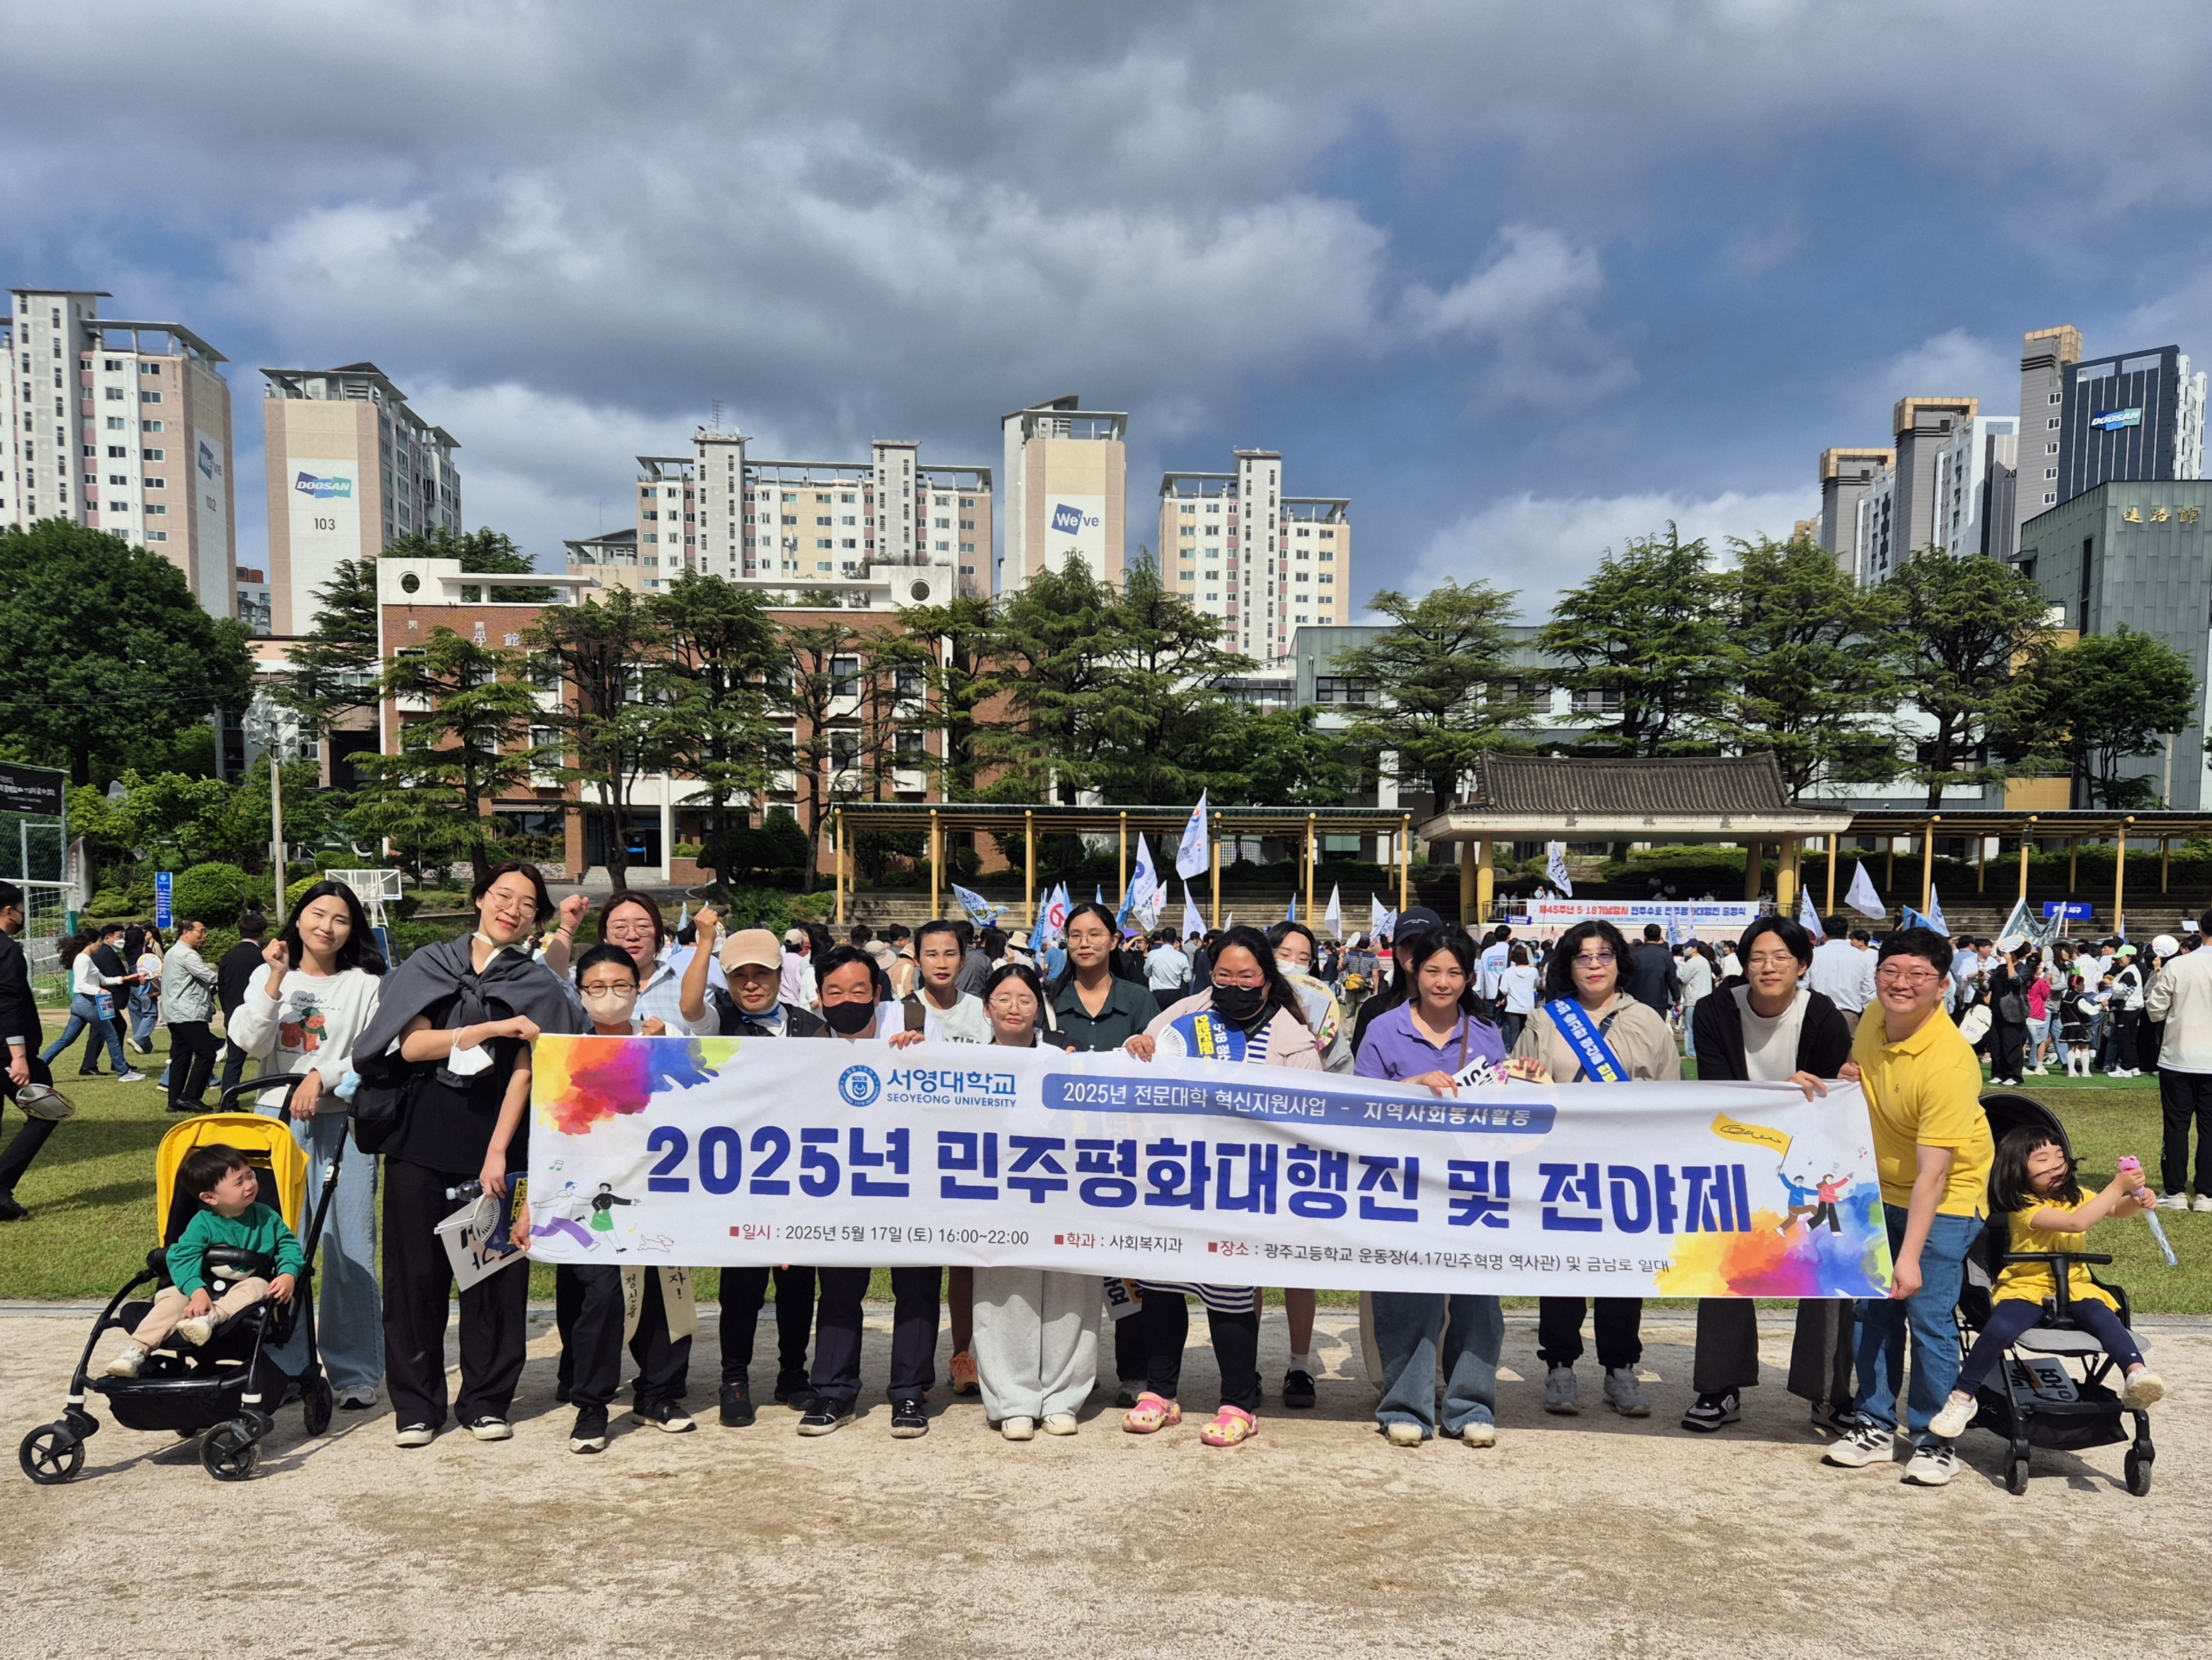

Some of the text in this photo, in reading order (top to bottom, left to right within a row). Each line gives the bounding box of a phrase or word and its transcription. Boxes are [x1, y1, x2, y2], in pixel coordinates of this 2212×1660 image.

[2091, 410, 2140, 426] DOOSAN
[296, 481, 350, 490] DOOSAN
[313, 518, 336, 531] 103
[1056, 513, 1100, 526] We've
[1062, 551, 1085, 562] 15
[1631, 906, 1662, 916] 민주수호
[887, 1068, 1017, 1095] 서영대학교
[887, 1093, 1017, 1107] SEOYEONG UNIVERSITY
[1064, 1082, 1127, 1105] 2025년
[1134, 1085, 1209, 1108] 전문대학
[1215, 1089, 1327, 1117] 혁신지원사업
[1364, 1102, 1531, 1126] 지역사회봉사활동
[647, 1126, 1752, 1234] 2025년 민주평화대행진 및 전야제
[742, 1224, 771, 1240] 일시
[785, 1225, 836, 1241] 2025년
[841, 1226, 865, 1242] 5월
[870, 1226, 902, 1243] 17일
[907, 1226, 933, 1243] (토)
[938, 1228, 1029, 1245] 16:00~22:00
[1066, 1233, 1095, 1249] 학과
[1110, 1234, 1183, 1253] 사회복지과
[1220, 1240, 1249, 1256] 장소
[1264, 1243, 1353, 1262] 광주고등학교
[1358, 1247, 1503, 1270] 운동장(4.17민주혁명
[1509, 1254, 1560, 1272] 역사관)
[1567, 1256, 1581, 1272] 및
[1587, 1256, 1632, 1272] 금남로
[1638, 1260, 1670, 1274] 일대
[667, 1266, 686, 1299] 자!
